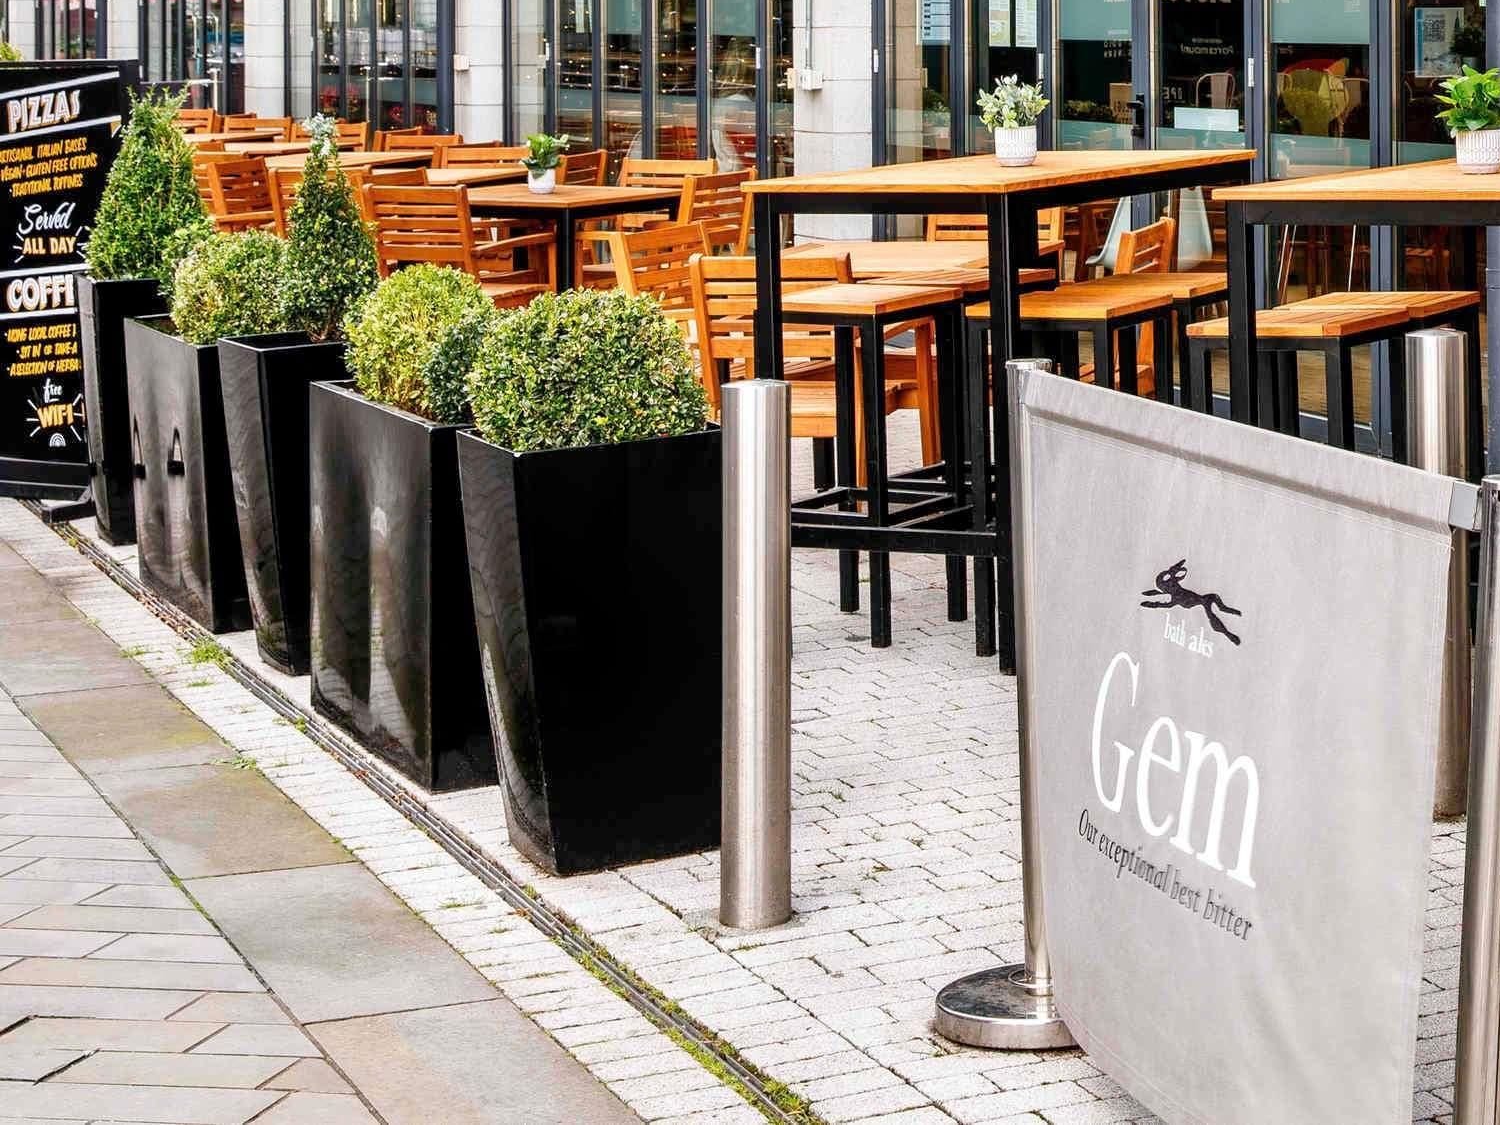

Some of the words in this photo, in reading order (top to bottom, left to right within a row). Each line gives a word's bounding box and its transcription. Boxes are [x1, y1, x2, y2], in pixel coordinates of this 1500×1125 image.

[6, 89, 81, 134] PIZZAS
[26, 160, 51, 178] GLUTEN
[52, 158, 69, 174] FREE
[70, 152, 98, 170] OPTIONS
[18, 202, 76, 235] Served
[23, 237, 46, 255] ALL
[50, 236, 77, 254] DAY
[48, 324, 71, 339] COFFEE
[19, 345, 31, 359] SIT
[32, 343, 41, 358] IN
[44, 344, 53, 355] OR
[48, 360, 55, 372] OF
[43, 378, 63, 404] free
[38, 403, 74, 428] WIFI
[1164, 612, 1185, 647] bath
[1188, 627, 1214, 658] ales
[1092, 651, 1260, 889] Gem
[1079, 809, 1098, 845] Our
[1098, 832, 1171, 893] exceptional
[1170, 870, 1200, 913] best
[1203, 889, 1252, 941] bitter
